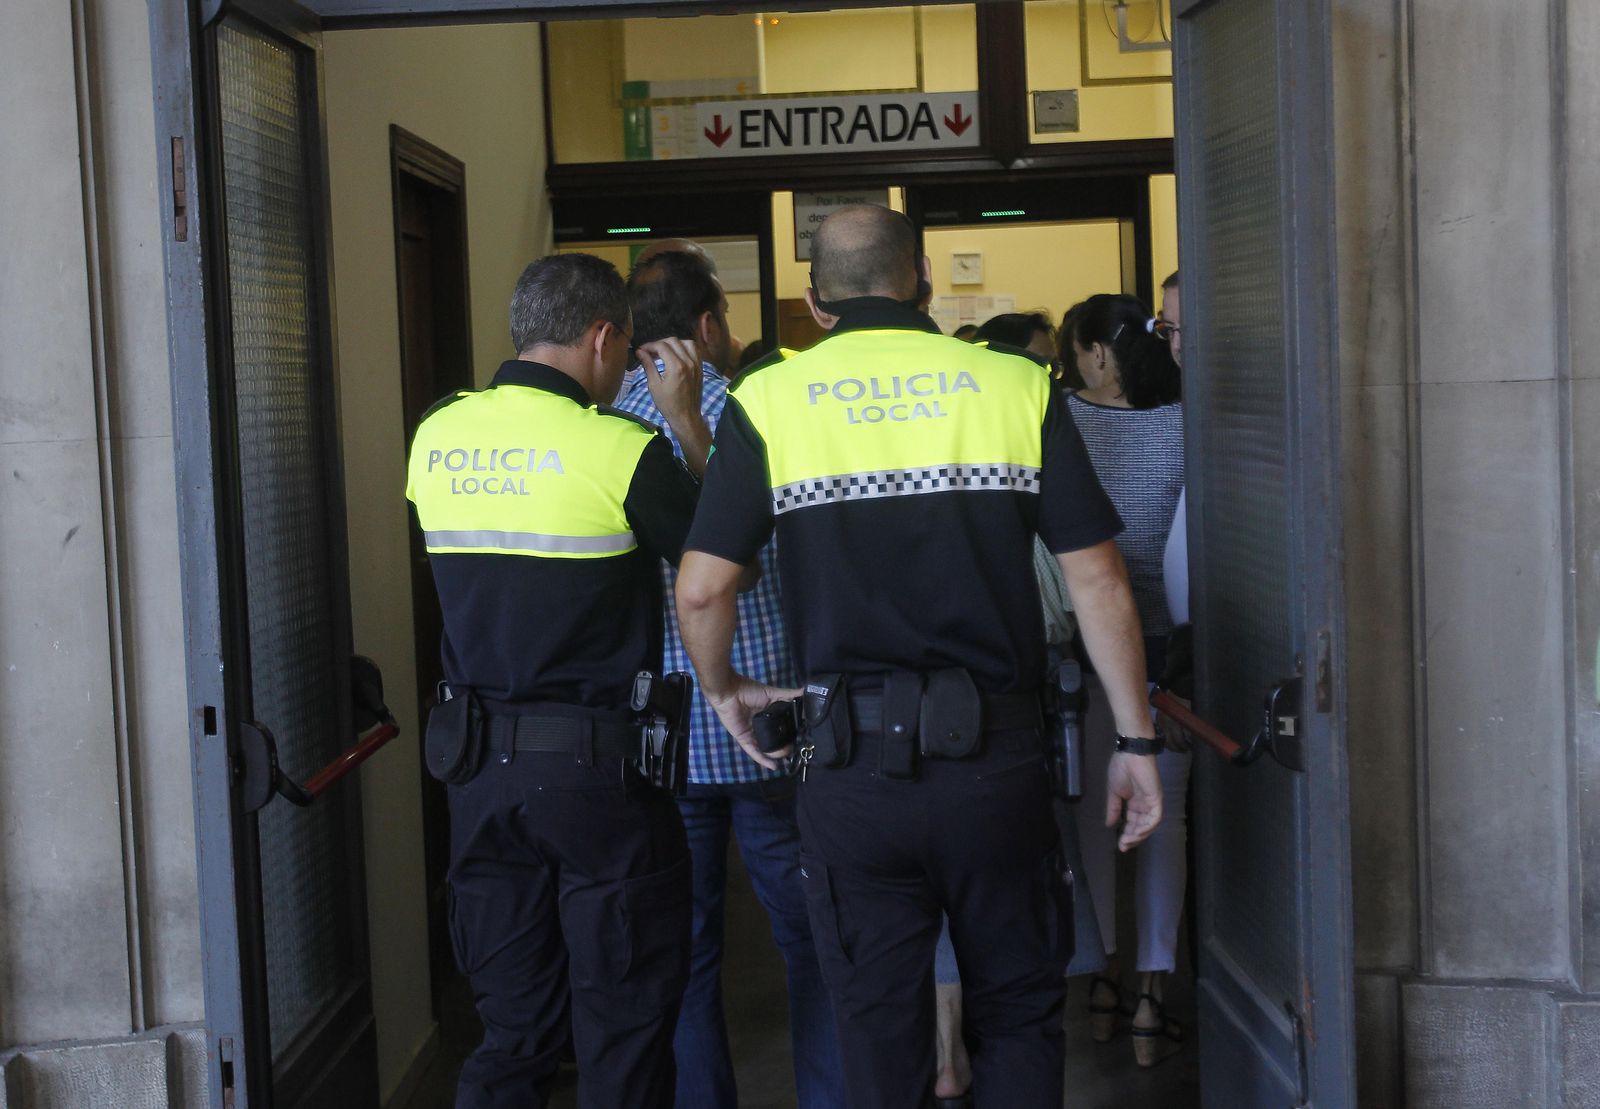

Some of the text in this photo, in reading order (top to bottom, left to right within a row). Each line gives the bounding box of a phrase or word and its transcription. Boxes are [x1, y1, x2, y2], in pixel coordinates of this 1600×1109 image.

[740, 102, 940, 148] ENTRADA
[808, 371, 981, 405] POLICIA
[847, 400, 947, 424] LOCAL
[428, 448, 565, 474] POLICIA
[451, 477, 530, 495] LOCAL
